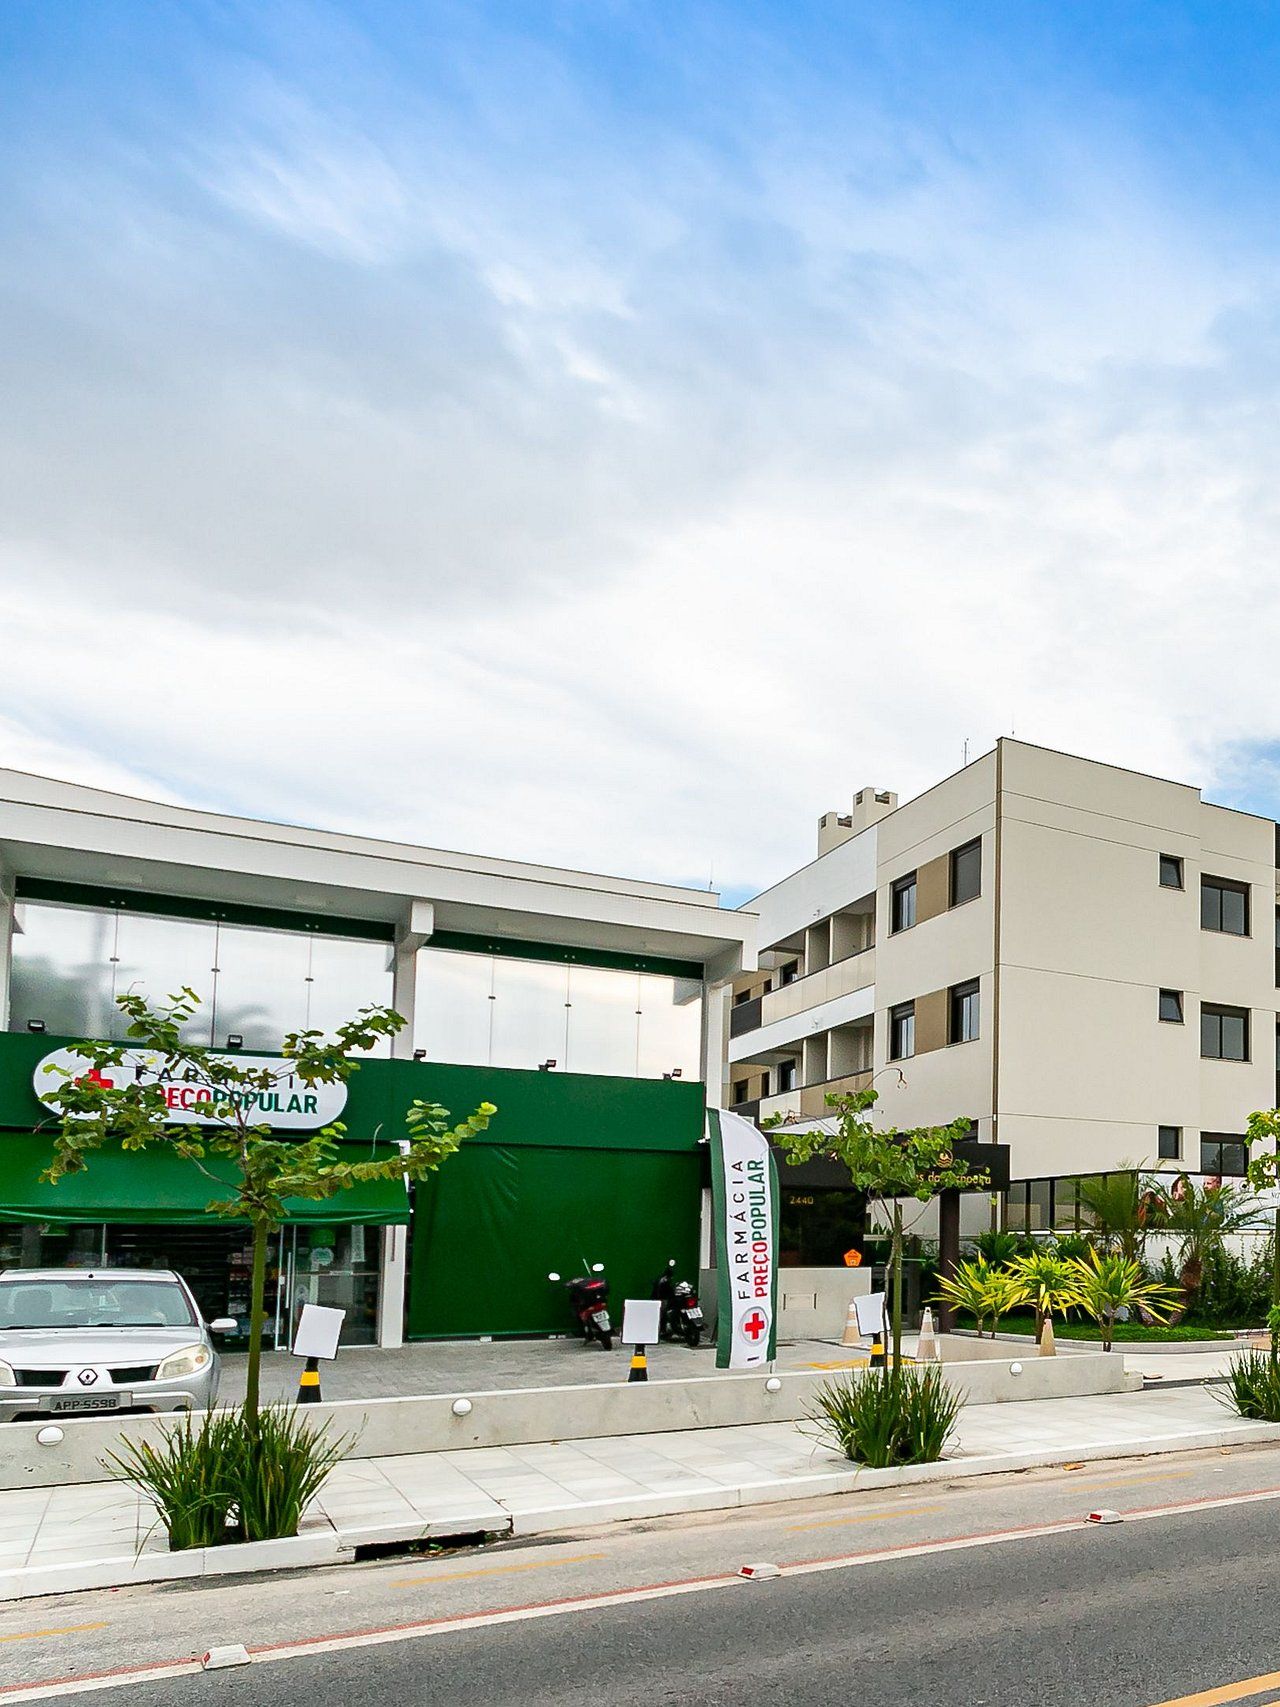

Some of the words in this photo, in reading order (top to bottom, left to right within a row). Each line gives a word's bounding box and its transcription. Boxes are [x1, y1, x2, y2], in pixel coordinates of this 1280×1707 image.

[152, 1086, 318, 1114] EÇOPOPULAR
[730, 1160, 751, 1300] FARMÁCIA
[747, 1158, 770, 1298] PREÇOPOPULAR
[788, 1195, 814, 1205] 2440
